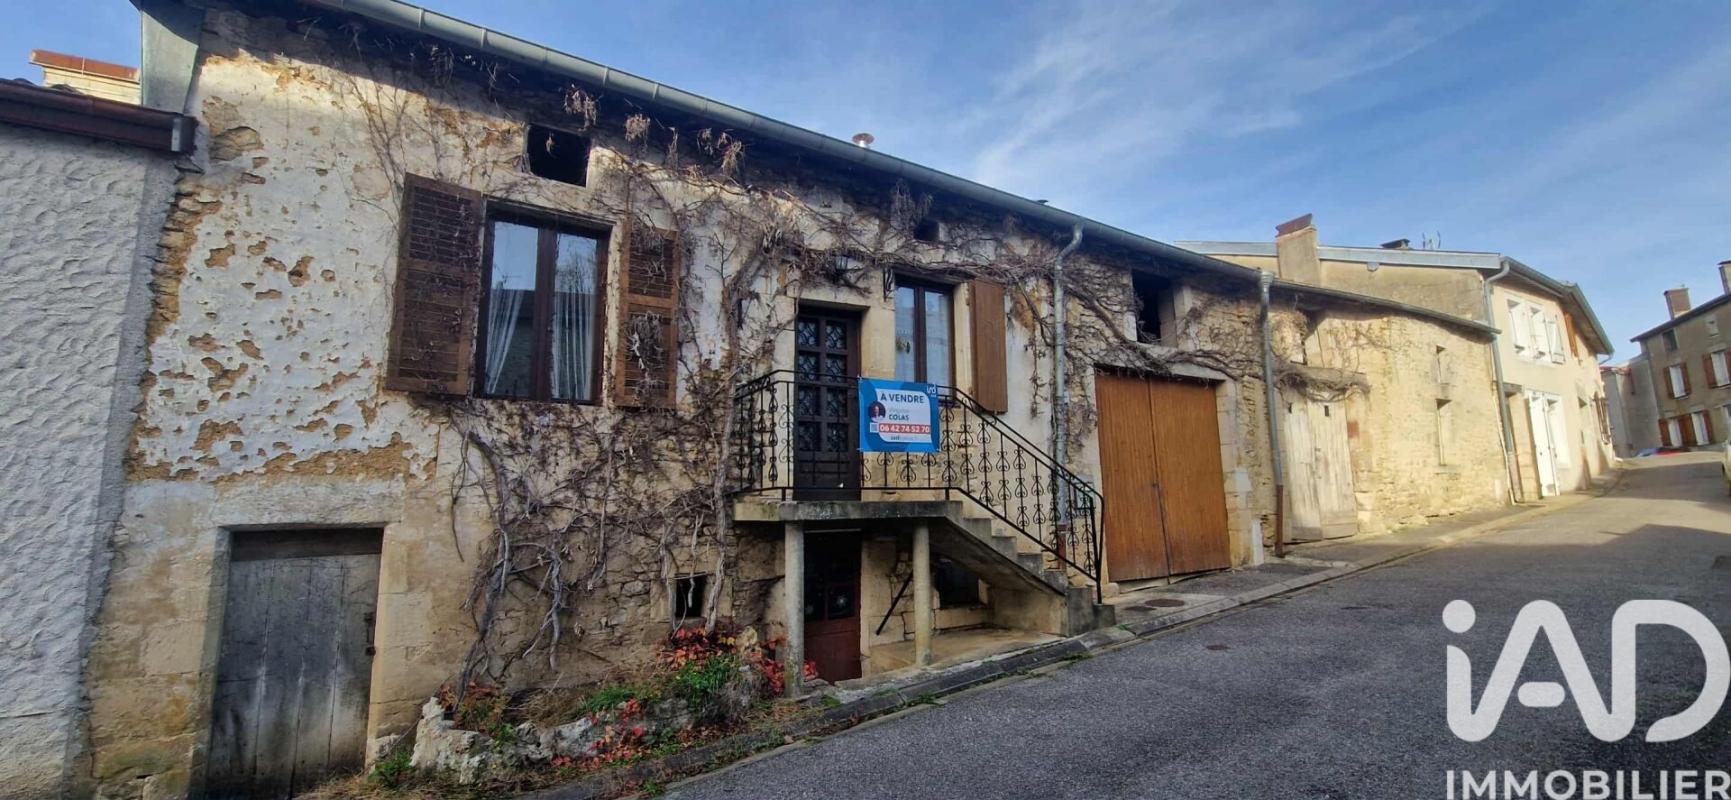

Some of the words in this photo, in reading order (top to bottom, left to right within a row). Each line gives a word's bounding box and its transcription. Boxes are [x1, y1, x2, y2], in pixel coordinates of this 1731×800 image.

[889, 393, 925, 403] VENDRE
[880, 424, 889, 432] 06
[890, 424, 900, 432] 42
[921, 425, 930, 433] 70
